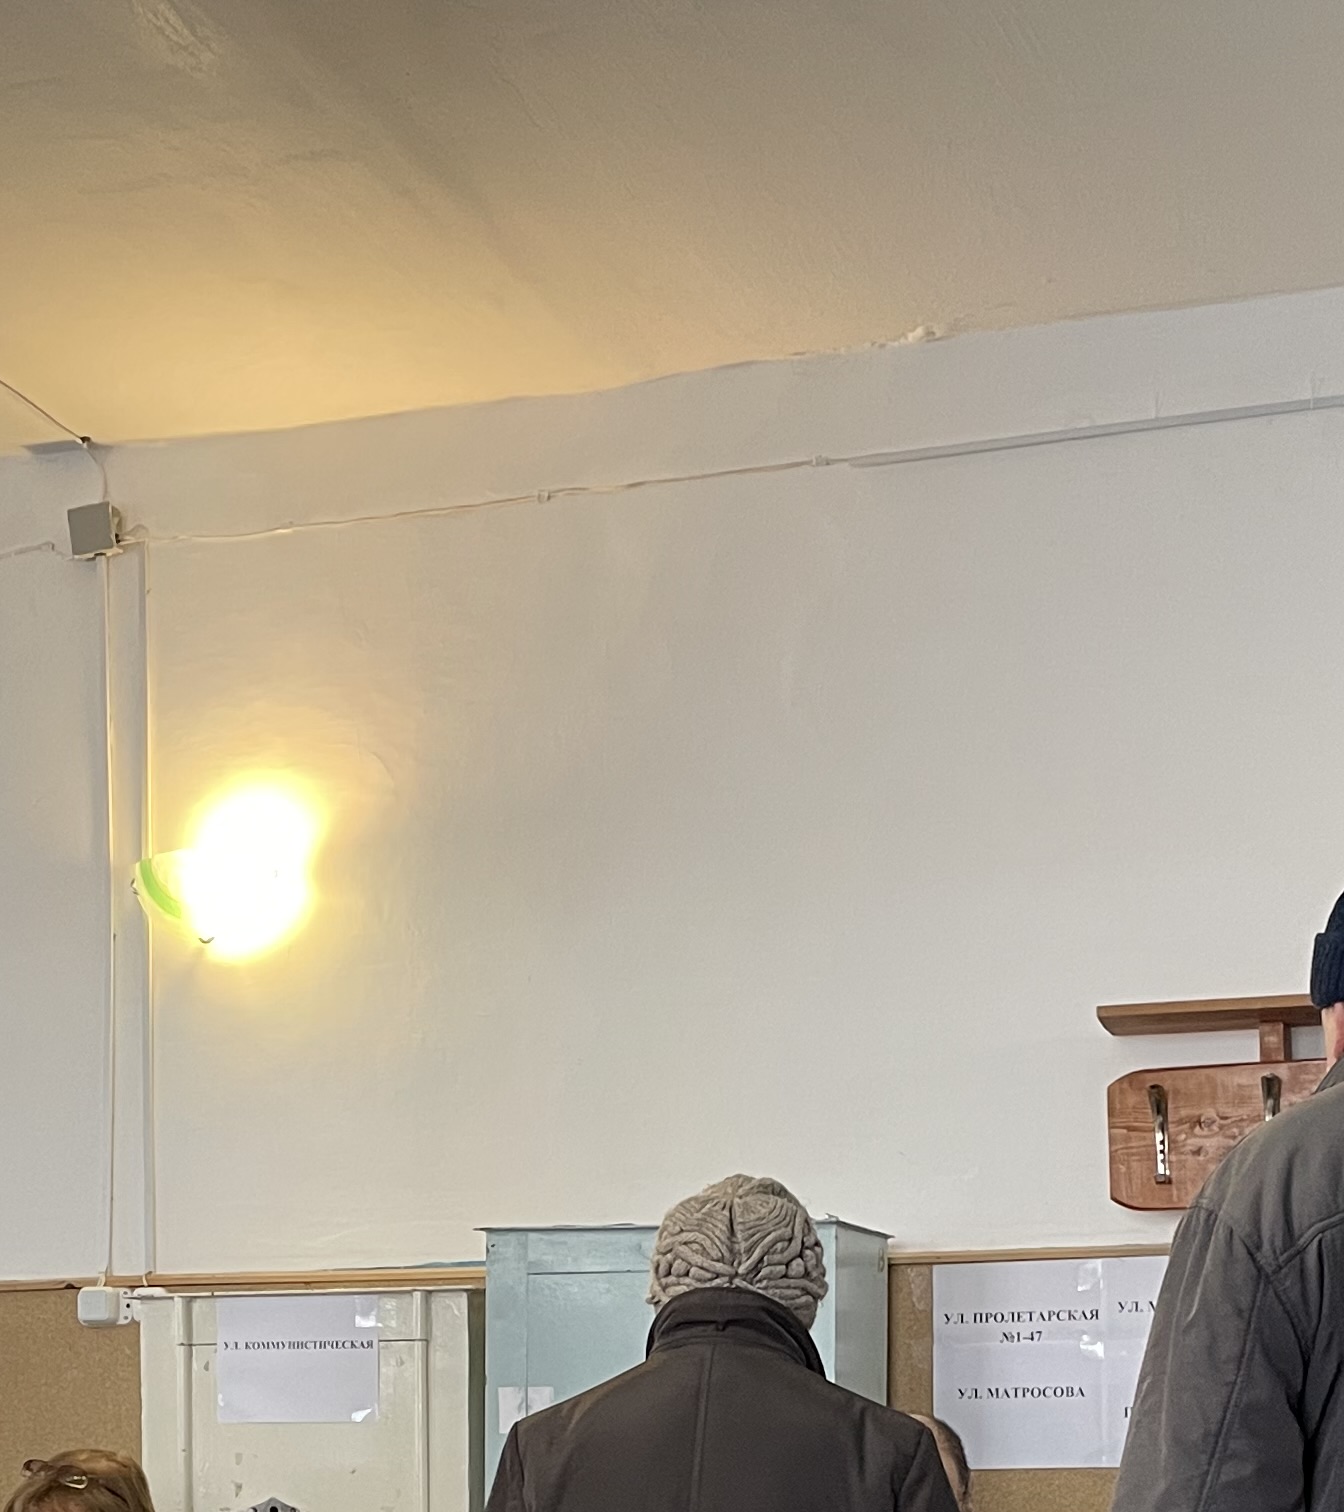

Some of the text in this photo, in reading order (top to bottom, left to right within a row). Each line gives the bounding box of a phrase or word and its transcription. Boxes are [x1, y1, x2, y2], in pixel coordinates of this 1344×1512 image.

[1118, 1300, 1144, 1312] УЛ.
[944, 1308, 1100, 1325] УЛ. ПРОЛЕТАРСКАЯ
[245, 1339, 374, 1350] КОММУНИСТИЧЕСКАЯ
[957, 1386, 1086, 1400] УЛ. МАТРОСОВА
